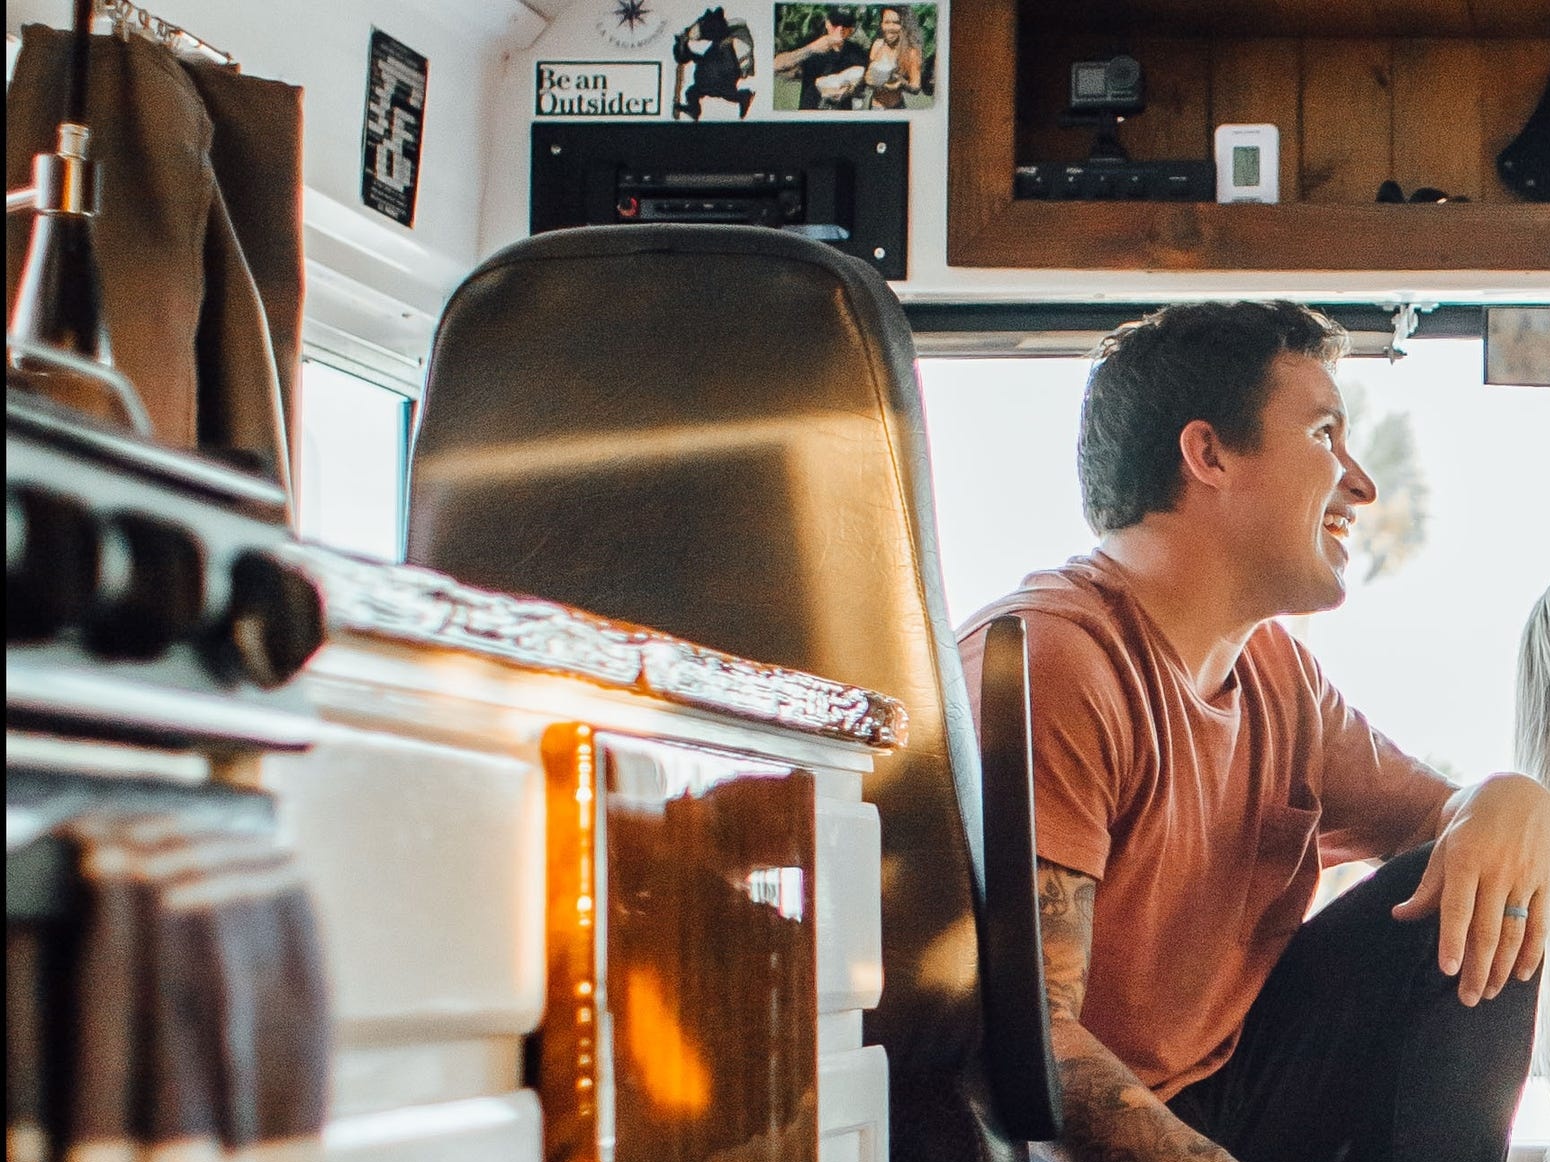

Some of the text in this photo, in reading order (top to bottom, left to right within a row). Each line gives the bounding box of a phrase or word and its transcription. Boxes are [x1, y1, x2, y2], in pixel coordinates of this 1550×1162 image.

[540, 67, 607, 90] Be an
[539, 92, 654, 115] Outsider
